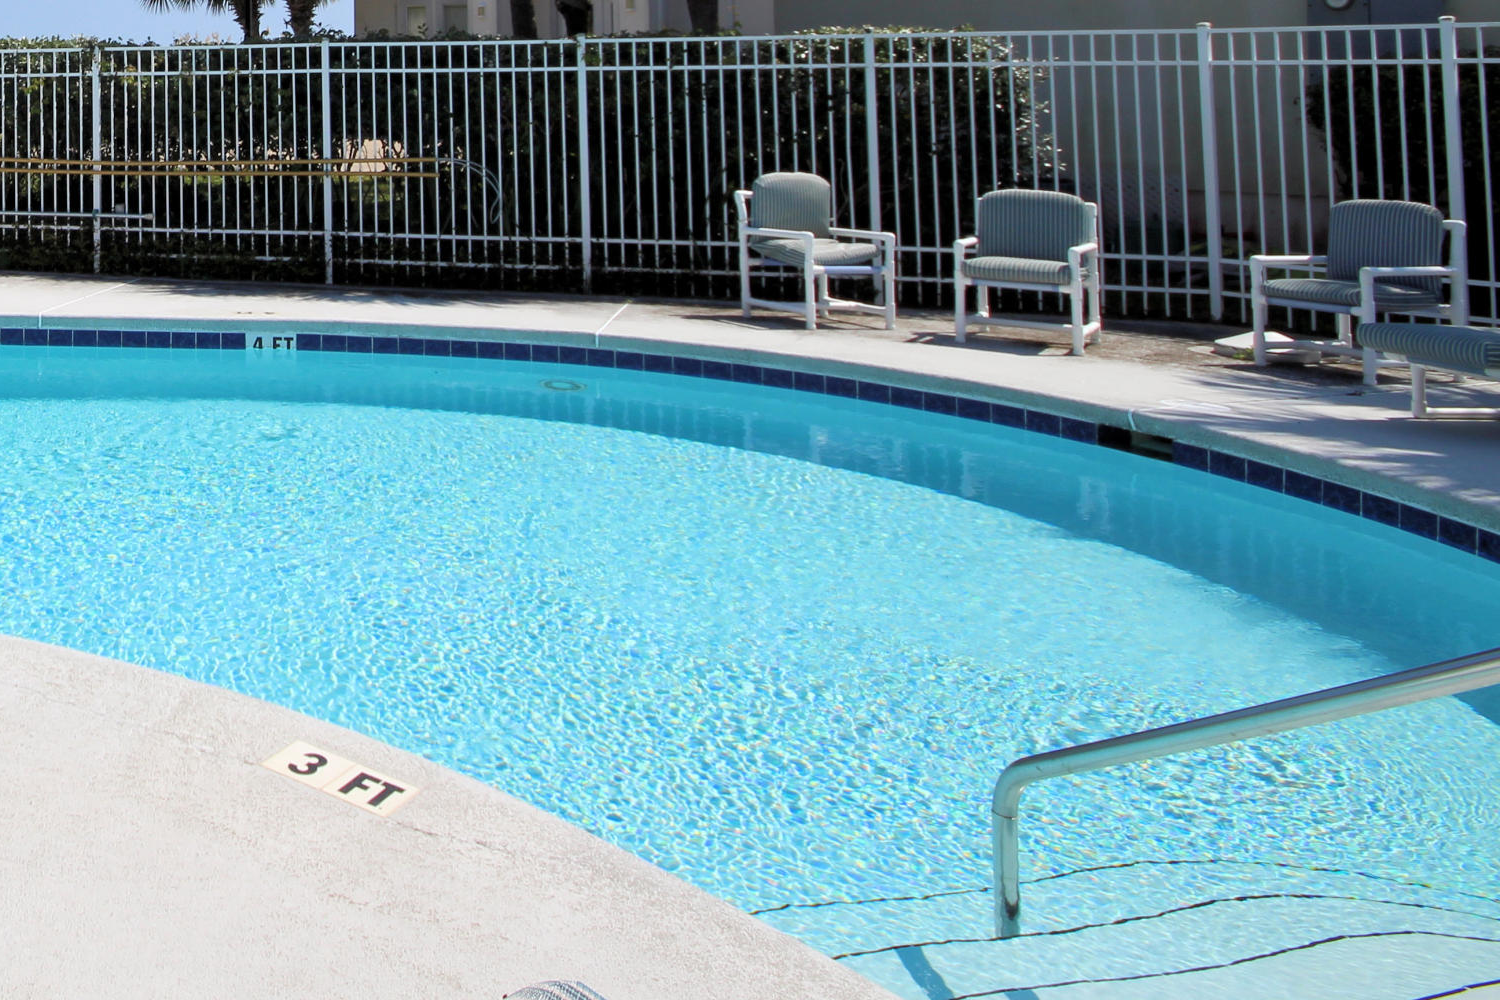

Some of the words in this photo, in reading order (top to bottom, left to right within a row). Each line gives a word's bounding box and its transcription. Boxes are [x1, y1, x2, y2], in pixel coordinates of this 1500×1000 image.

[253, 336, 263, 349] 4
[272, 336, 294, 350] FT
[287, 752, 328, 776] 3
[337, 771, 406, 807] FT
